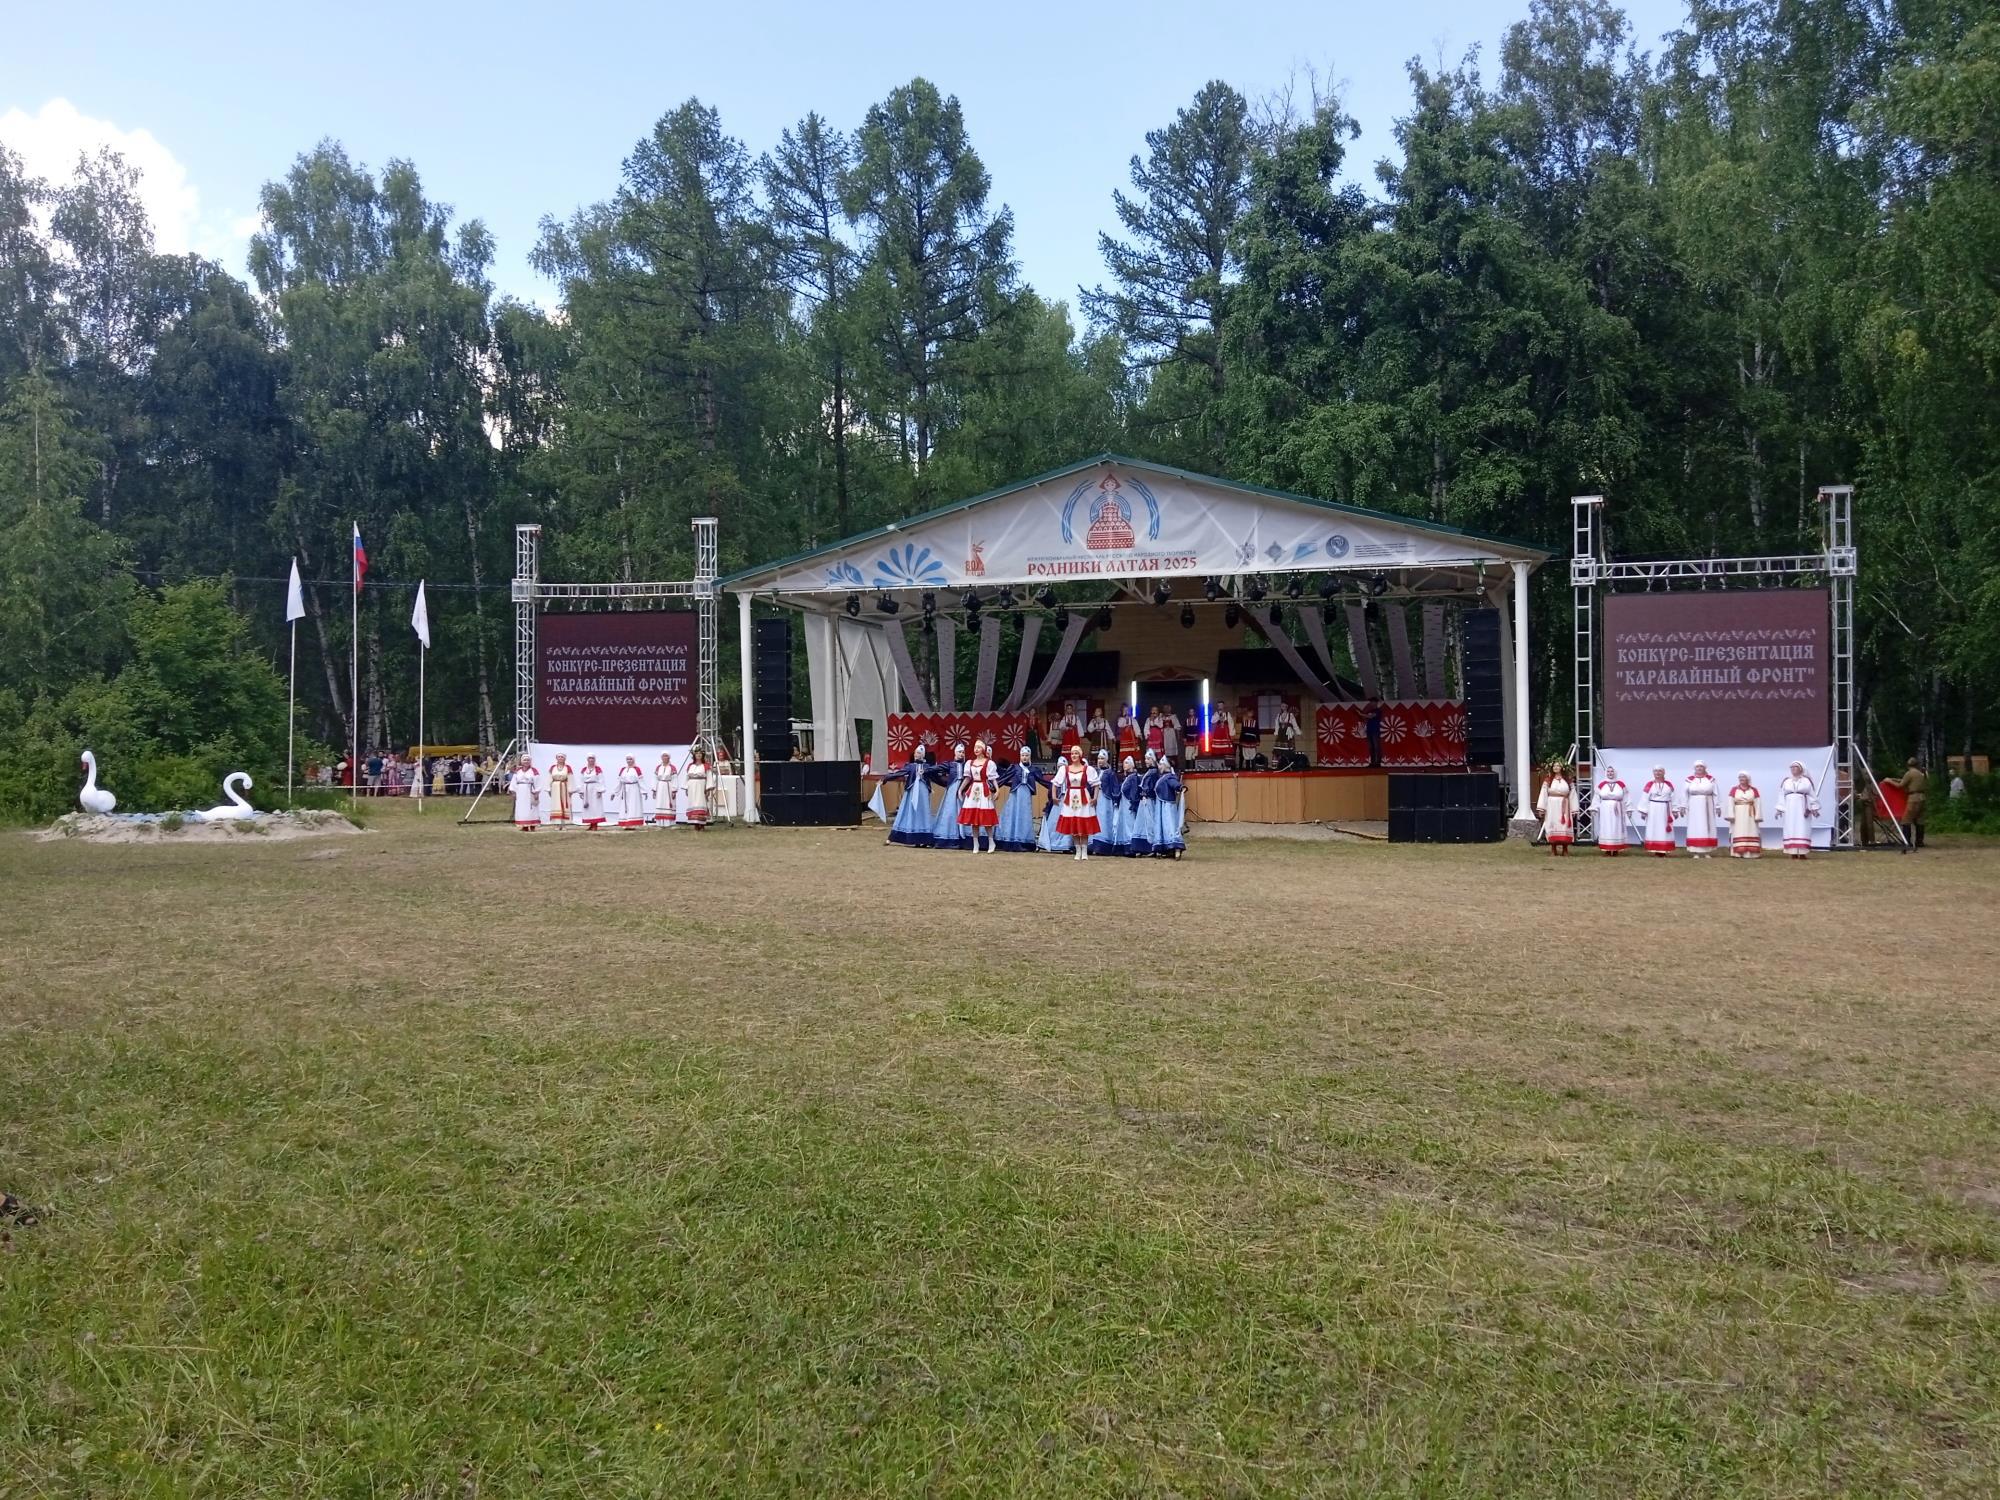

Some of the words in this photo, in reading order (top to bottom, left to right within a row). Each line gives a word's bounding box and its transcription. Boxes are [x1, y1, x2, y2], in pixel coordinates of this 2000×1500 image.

[1028, 560, 1101, 576] РОДНИКИ
[1106, 558, 1160, 572] АЛТАЯ
[1164, 557, 1197, 570] 2025
[1617, 644, 1814, 666] КОНКУРС-ПРЕЗЕНТАЦИЯ
[547, 659, 687, 674] КОНКУРС-ПРЕЗЕНТАЦИЯ
[1616, 666, 1741, 685] "КАРАВАЙНЫЙ
[1746, 667, 1815, 683] ФРОНТ"
[546, 676, 635, 692] "КАРАВАЙНЫЙ
[638, 677, 687, 691] ФРОНТ"
